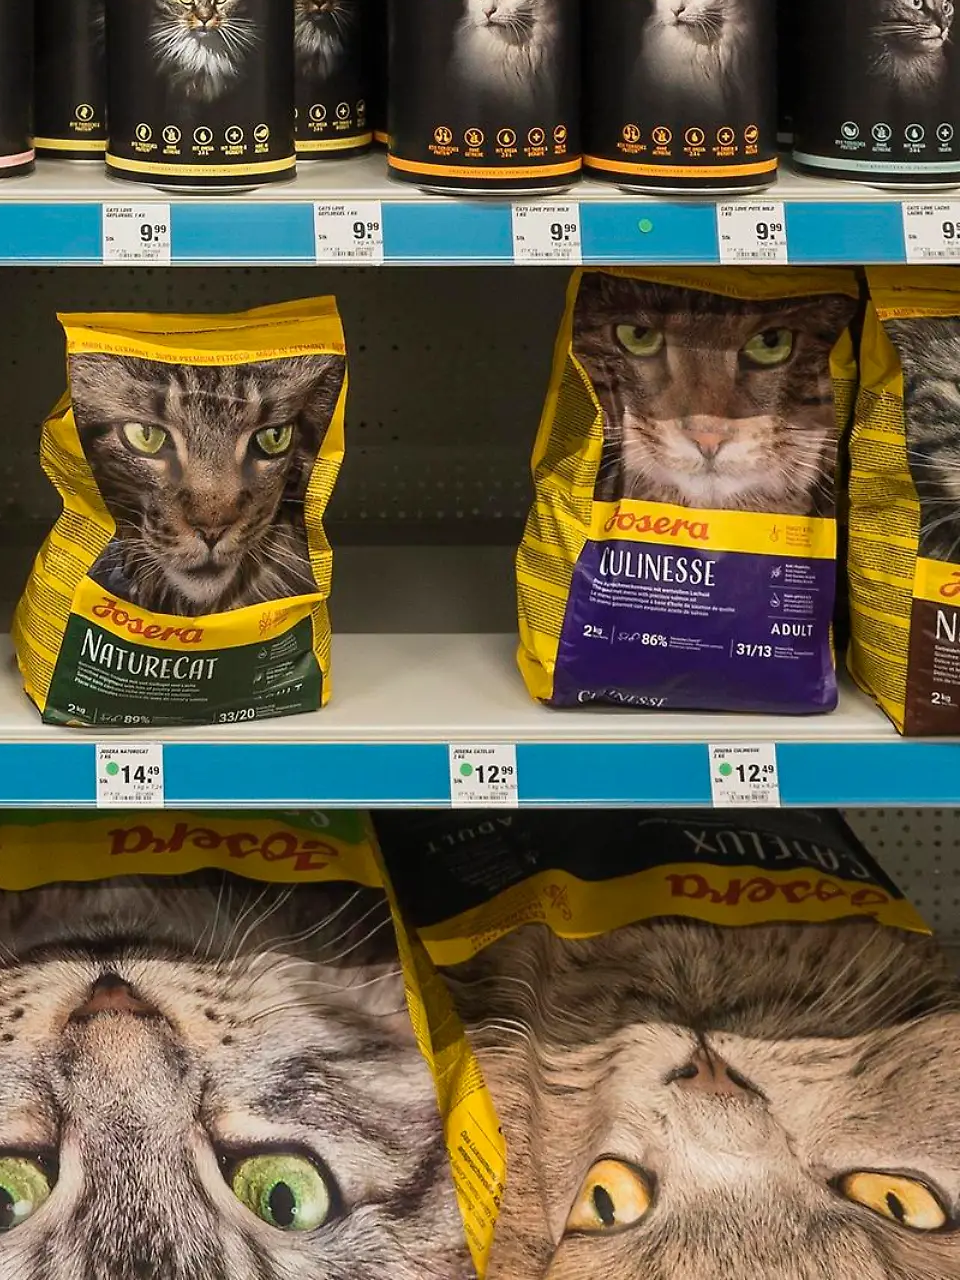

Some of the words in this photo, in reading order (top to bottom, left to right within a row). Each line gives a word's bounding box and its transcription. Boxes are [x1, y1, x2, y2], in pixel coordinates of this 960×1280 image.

[140, 224, 166, 242] 9.99
[550, 222, 577, 240] 9.99
[604, 505, 709, 541] Josera
[599, 547, 716, 587] CULINESSE
[92, 596, 204, 644] Josera
[771, 623, 813, 637] ADULT
[641, 634, 668, 647] 86%
[737, 643, 771, 658] 31/13
[124, 715, 150, 724] 89%
[219, 708, 255, 723] 33/20
[121, 765, 160, 783] 14.49
[475, 765, 513, 784] 12.99
[736, 764, 774, 783] 12.49
[108, 822, 339, 871] Josera
